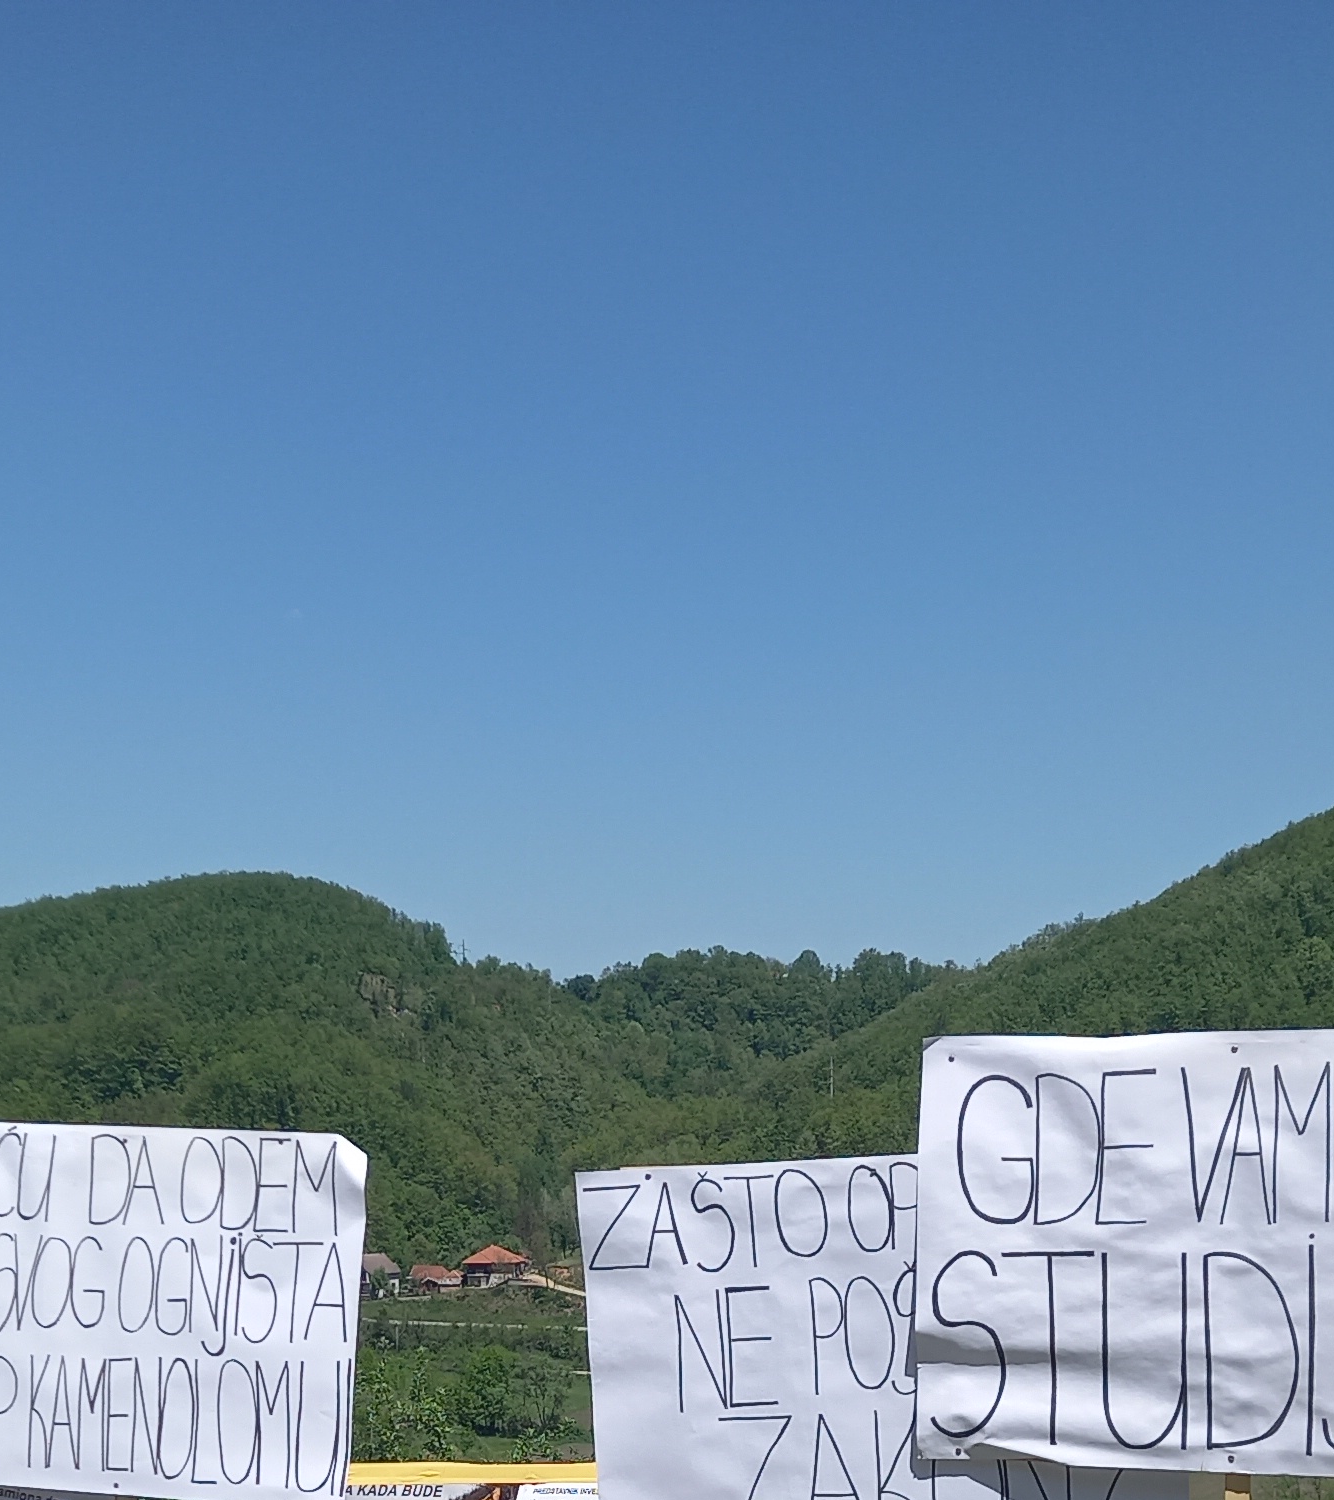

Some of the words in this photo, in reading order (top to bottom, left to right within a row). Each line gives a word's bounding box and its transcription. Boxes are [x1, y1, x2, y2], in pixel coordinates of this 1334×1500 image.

[88, 1133, 165, 1225] DA
[180, 1135, 339, 1236] ODEM
[957, 1068, 1157, 1226] GDE
[1180, 1060, 1331, 1226] VAM
[582, 1168, 829, 1273] ZAŠTO
[847, 1161, 917, 1252] OP
[673, 1285, 779, 1413] NE
[808, 1260, 916, 1396] POŠ
[357, 1485, 397, 1498] KADA
[401, 1485, 443, 1498] BUDE
